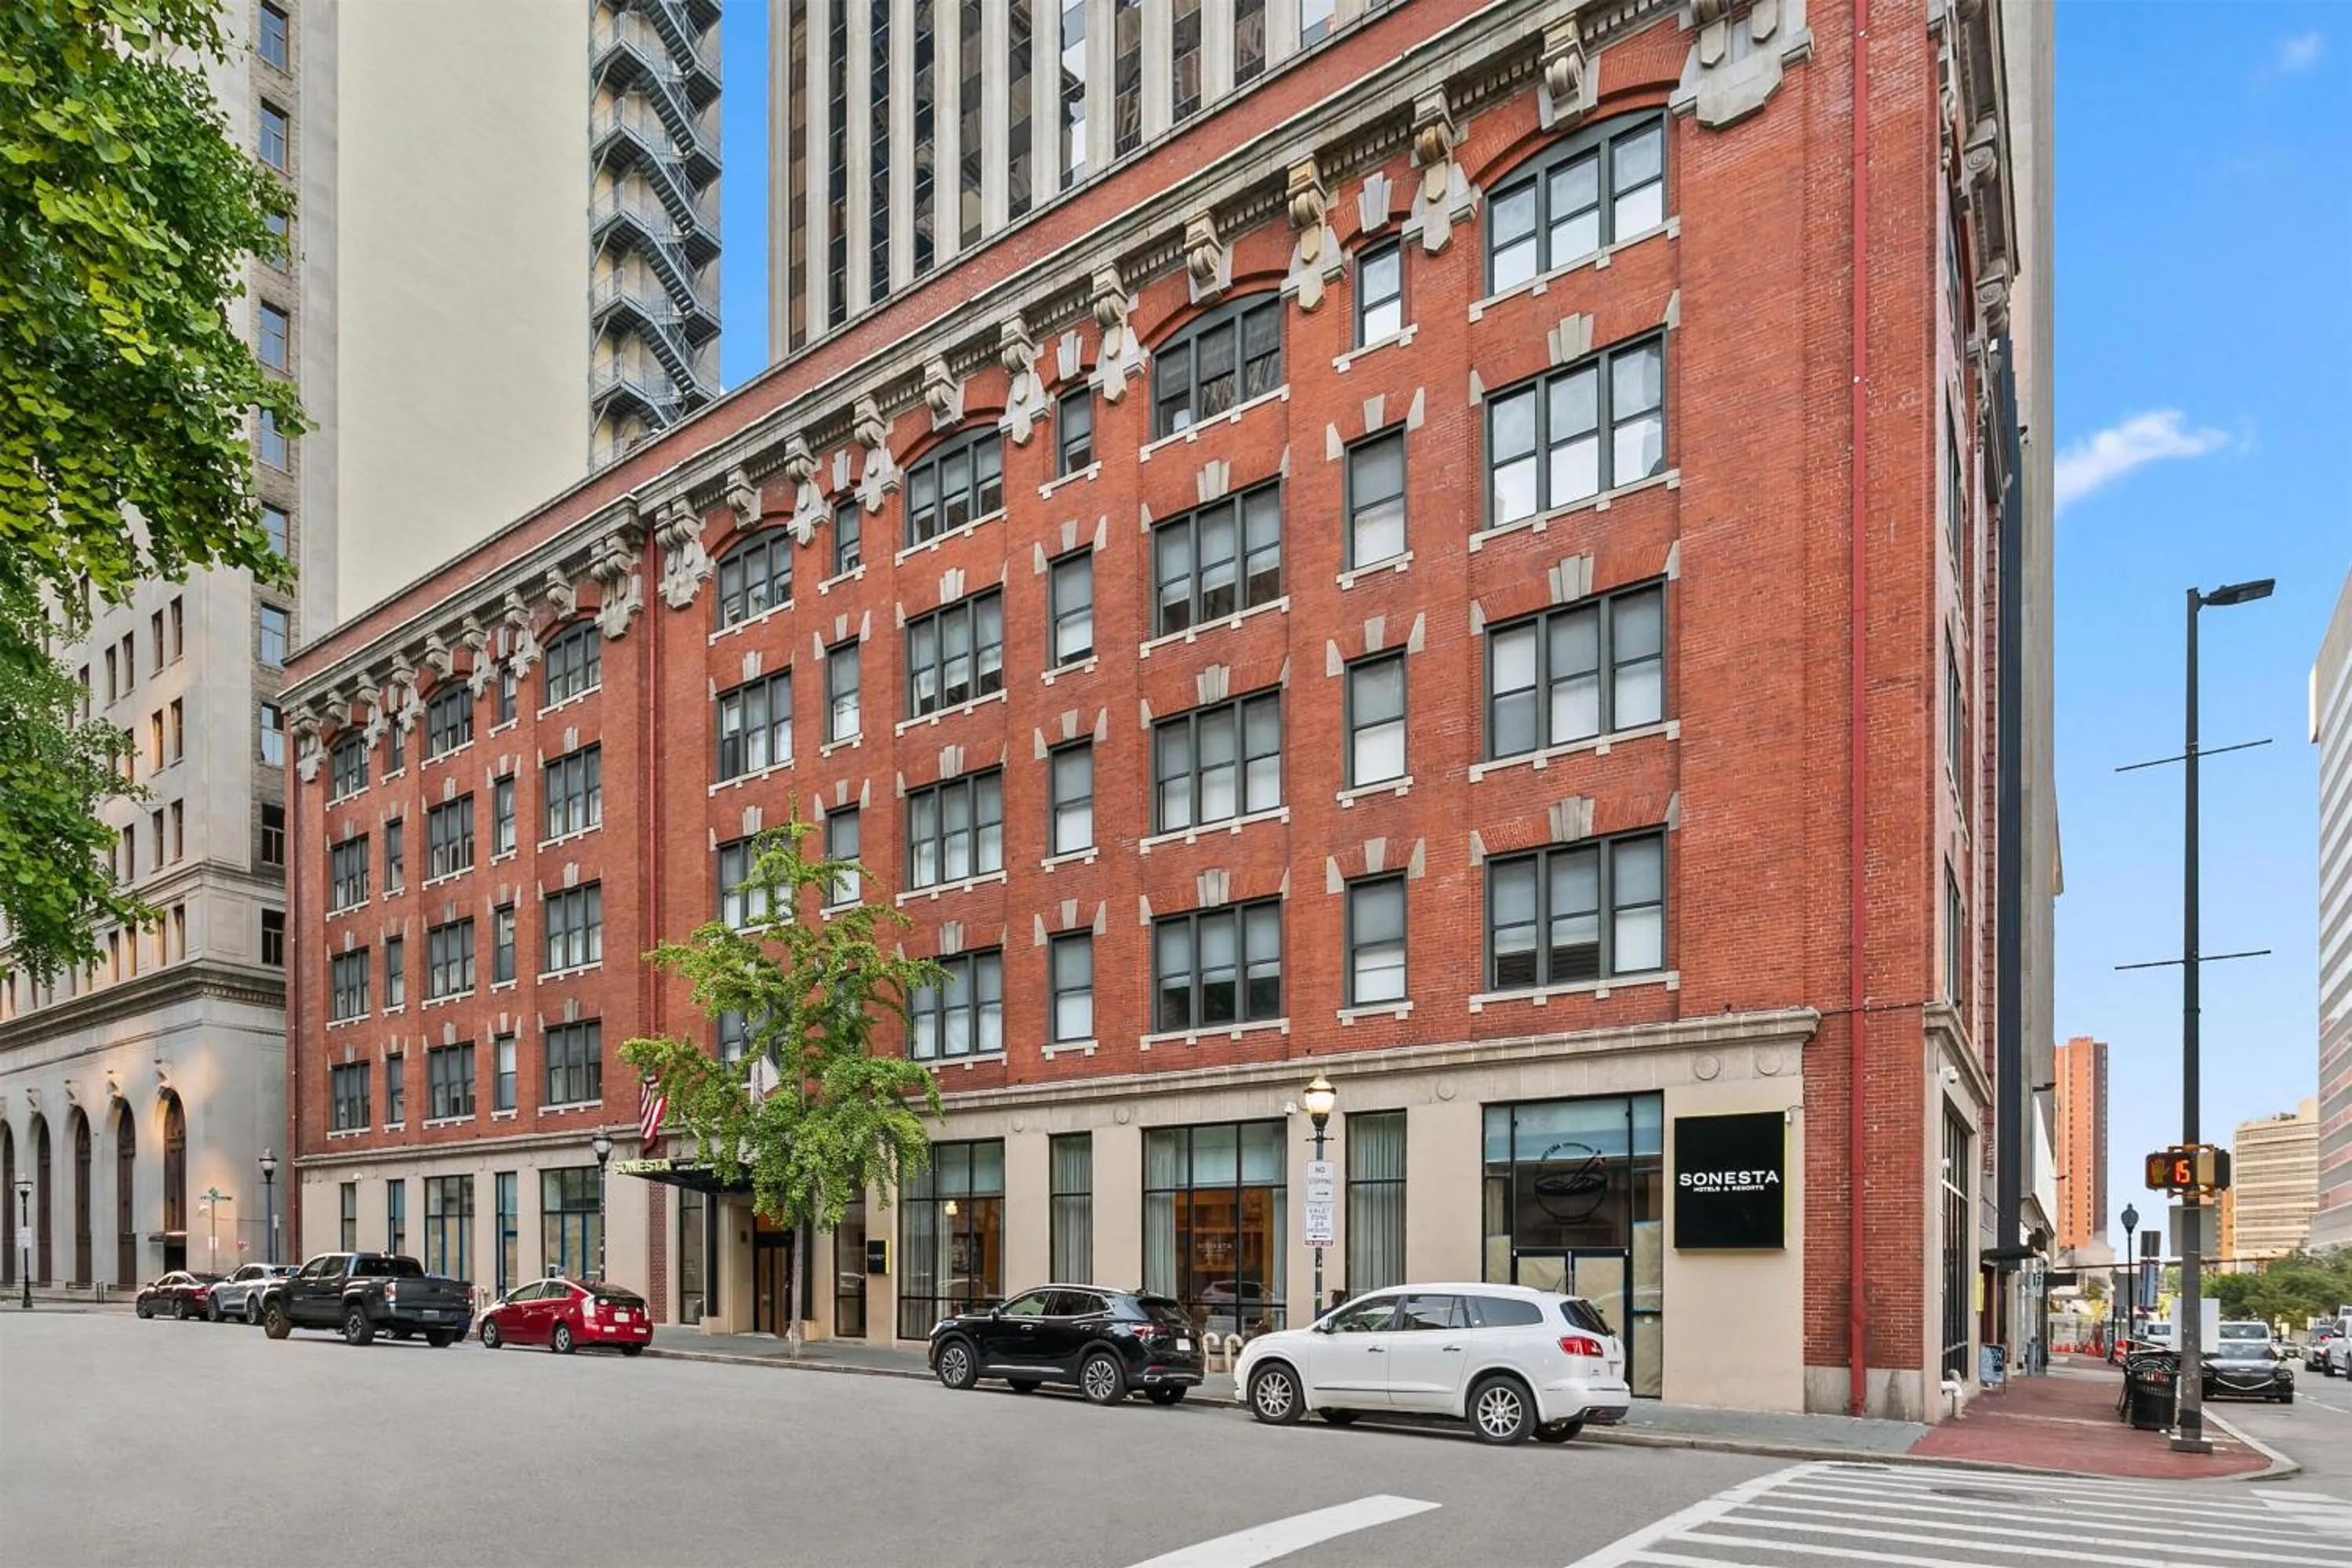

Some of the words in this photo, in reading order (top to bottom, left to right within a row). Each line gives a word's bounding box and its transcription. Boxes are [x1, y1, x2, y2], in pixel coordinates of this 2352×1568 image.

[615, 1160, 672, 1174] SONESTA
[2176, 1160, 2190, 1183] 15
[1679, 1170, 1779, 1186] SONESTA
